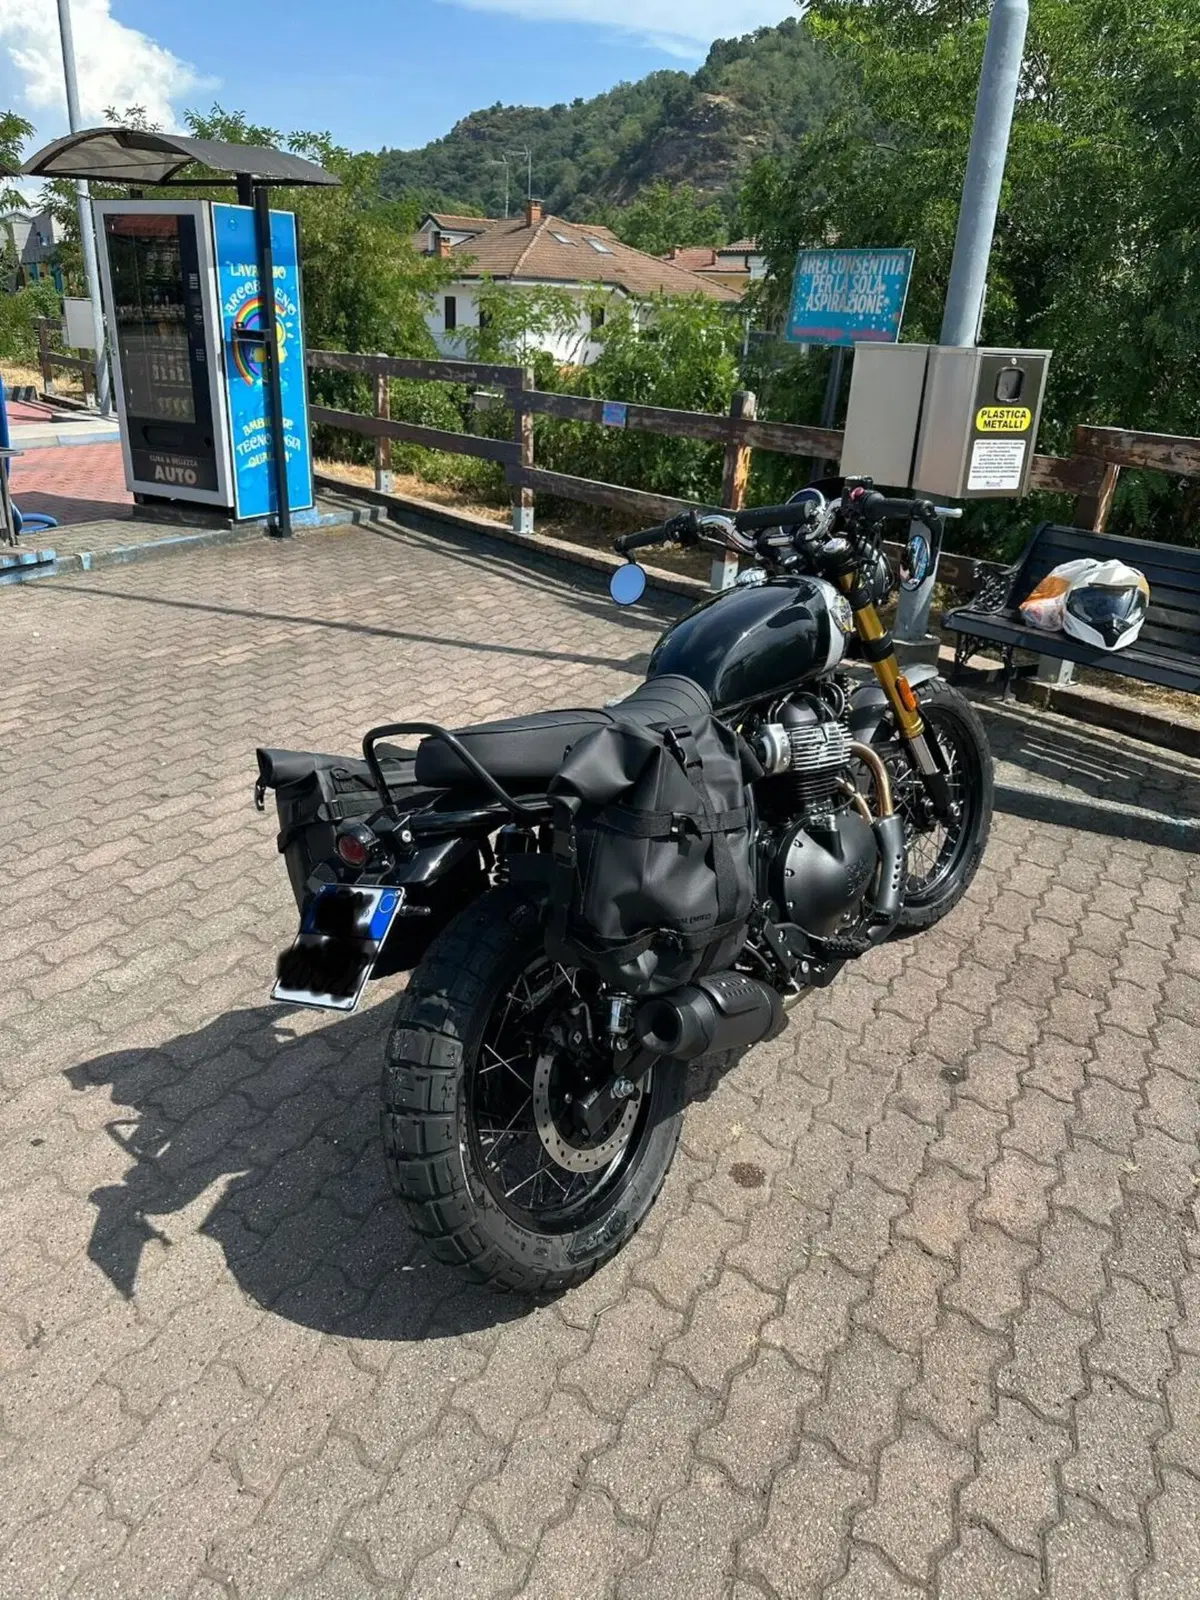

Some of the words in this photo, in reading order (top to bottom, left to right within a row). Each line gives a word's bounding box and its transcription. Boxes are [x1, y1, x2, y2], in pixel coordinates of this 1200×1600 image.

[230, 263, 286, 279] LAVAIO
[800, 256, 829, 274] AREA
[831, 256, 905, 275] CONSENTITA
[811, 274, 833, 293] PER
[834, 274, 848, 293] LA
[852, 274, 882, 294] SOLA
[225, 279, 296, 316] ARCOBENO
[805, 294, 884, 313] ASPIRAZIONE
[981, 410, 1027, 419] PLASTICA
[983, 420, 1023, 429] METALLI
[236, 433, 301, 456] TECNOGIA
[155, 464, 197, 484] AUTO
